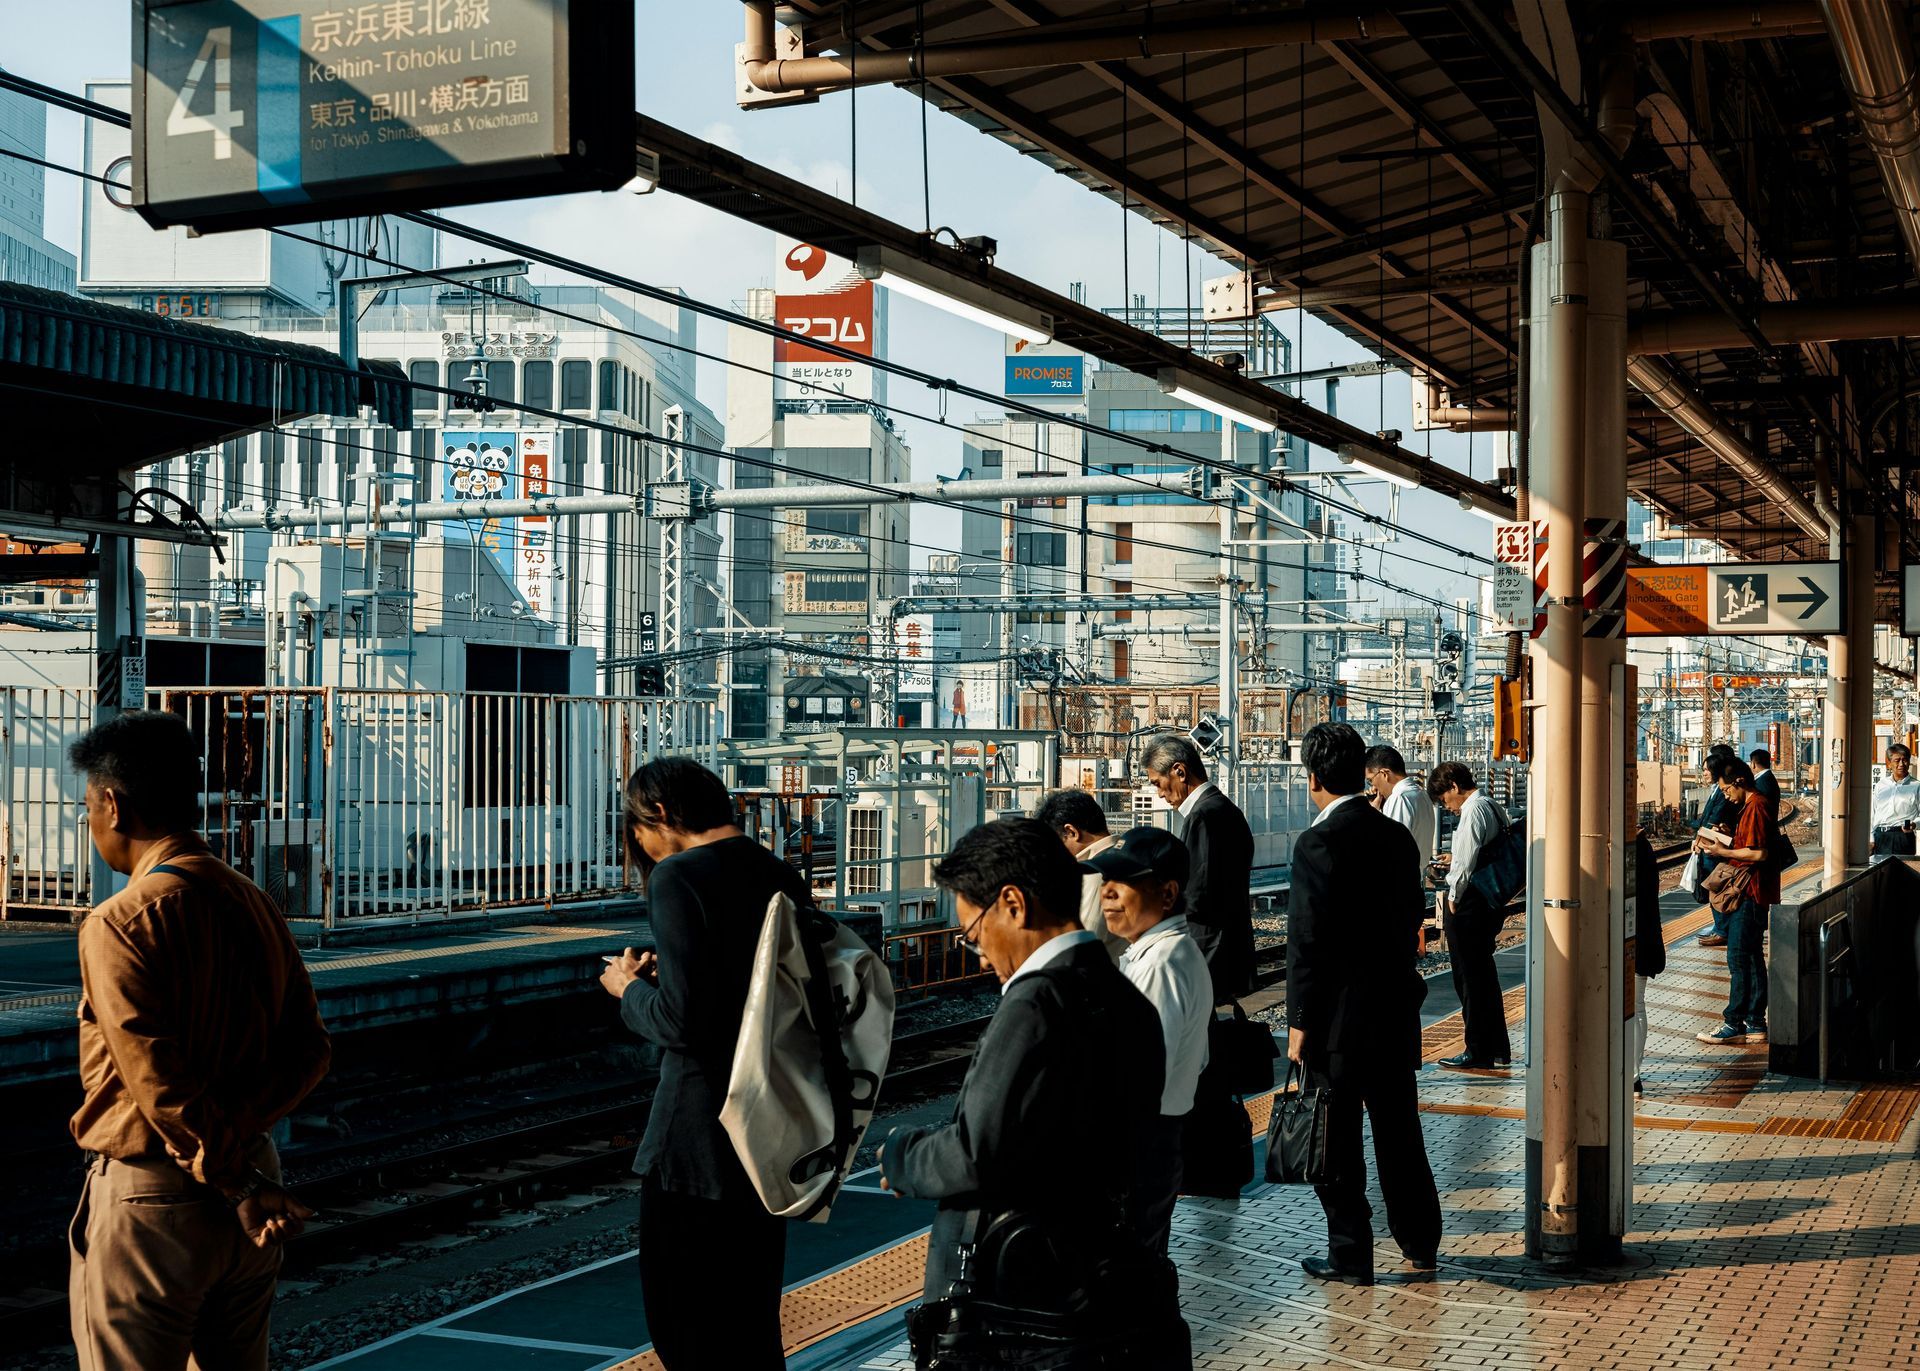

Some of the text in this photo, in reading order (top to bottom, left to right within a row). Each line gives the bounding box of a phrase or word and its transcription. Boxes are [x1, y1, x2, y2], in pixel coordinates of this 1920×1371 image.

[310, 0, 491, 53] 京浜東北線
[470, 37, 517, 61] Line
[166, 26, 244, 161] 4
[311, 136, 327, 150] for
[377, 122, 450, 143] Shinagawa
[452, 119, 464, 134] &
[466, 111, 539, 132] Yokohama
[784, 316, 866, 343] アコム
[792, 367, 853, 378] 当ビルとなり
[1014, 367, 1073, 380] PROMISE
[1050, 380, 1073, 388] プロミス
[1497, 566, 1529, 576] 非常停止
[1497, 578, 1521, 588] ボタン
[1635, 574, 1699, 591] 不忍改札
[1675, 593, 1699, 602] Gate
[1508, 611, 1514, 626] 4
[848, 769, 856, 781] 5
